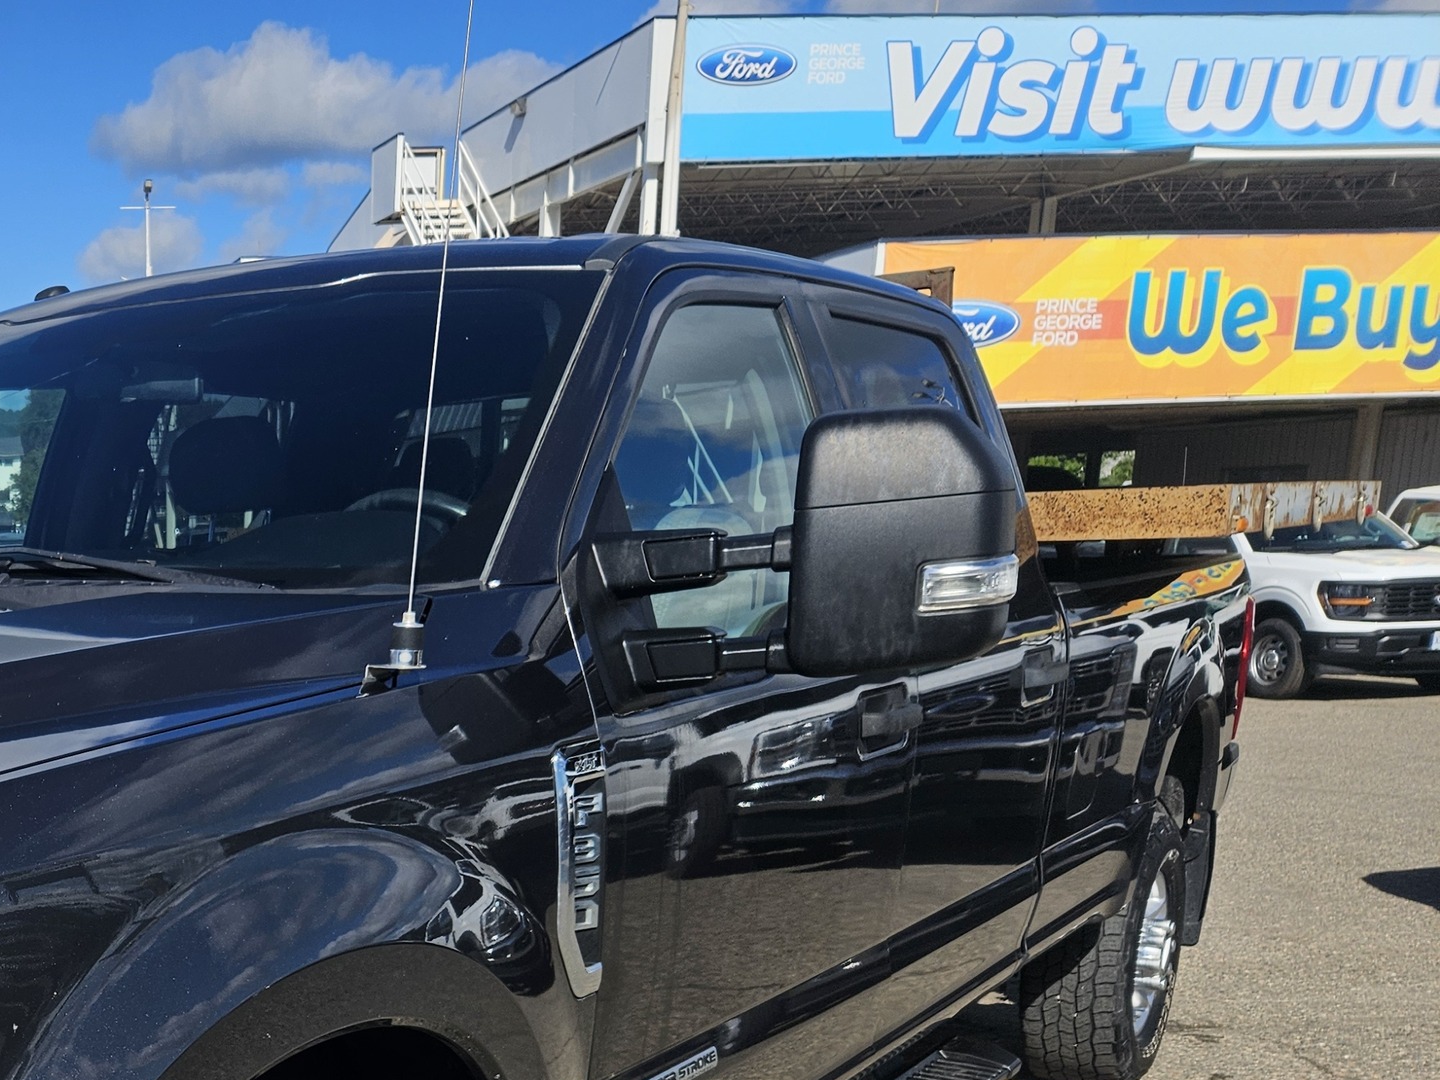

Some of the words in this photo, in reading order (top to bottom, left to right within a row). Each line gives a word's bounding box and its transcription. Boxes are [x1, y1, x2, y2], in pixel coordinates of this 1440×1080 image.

[809, 43, 863, 57] PRINCE
[714, 49, 779, 80] Ford
[808, 57, 866, 71] GEORGE
[806, 71, 846, 85] FORD
[886, 25, 1137, 139] Visit
[1035, 297, 1099, 314] PRINCE
[1033, 313, 1104, 331] GEORGE
[1127, 269, 1270, 356] We
[1292, 267, 1440, 371] Buy
[1031, 330, 1079, 347] FORD
[677, 1050, 717, 1080] STROKE
